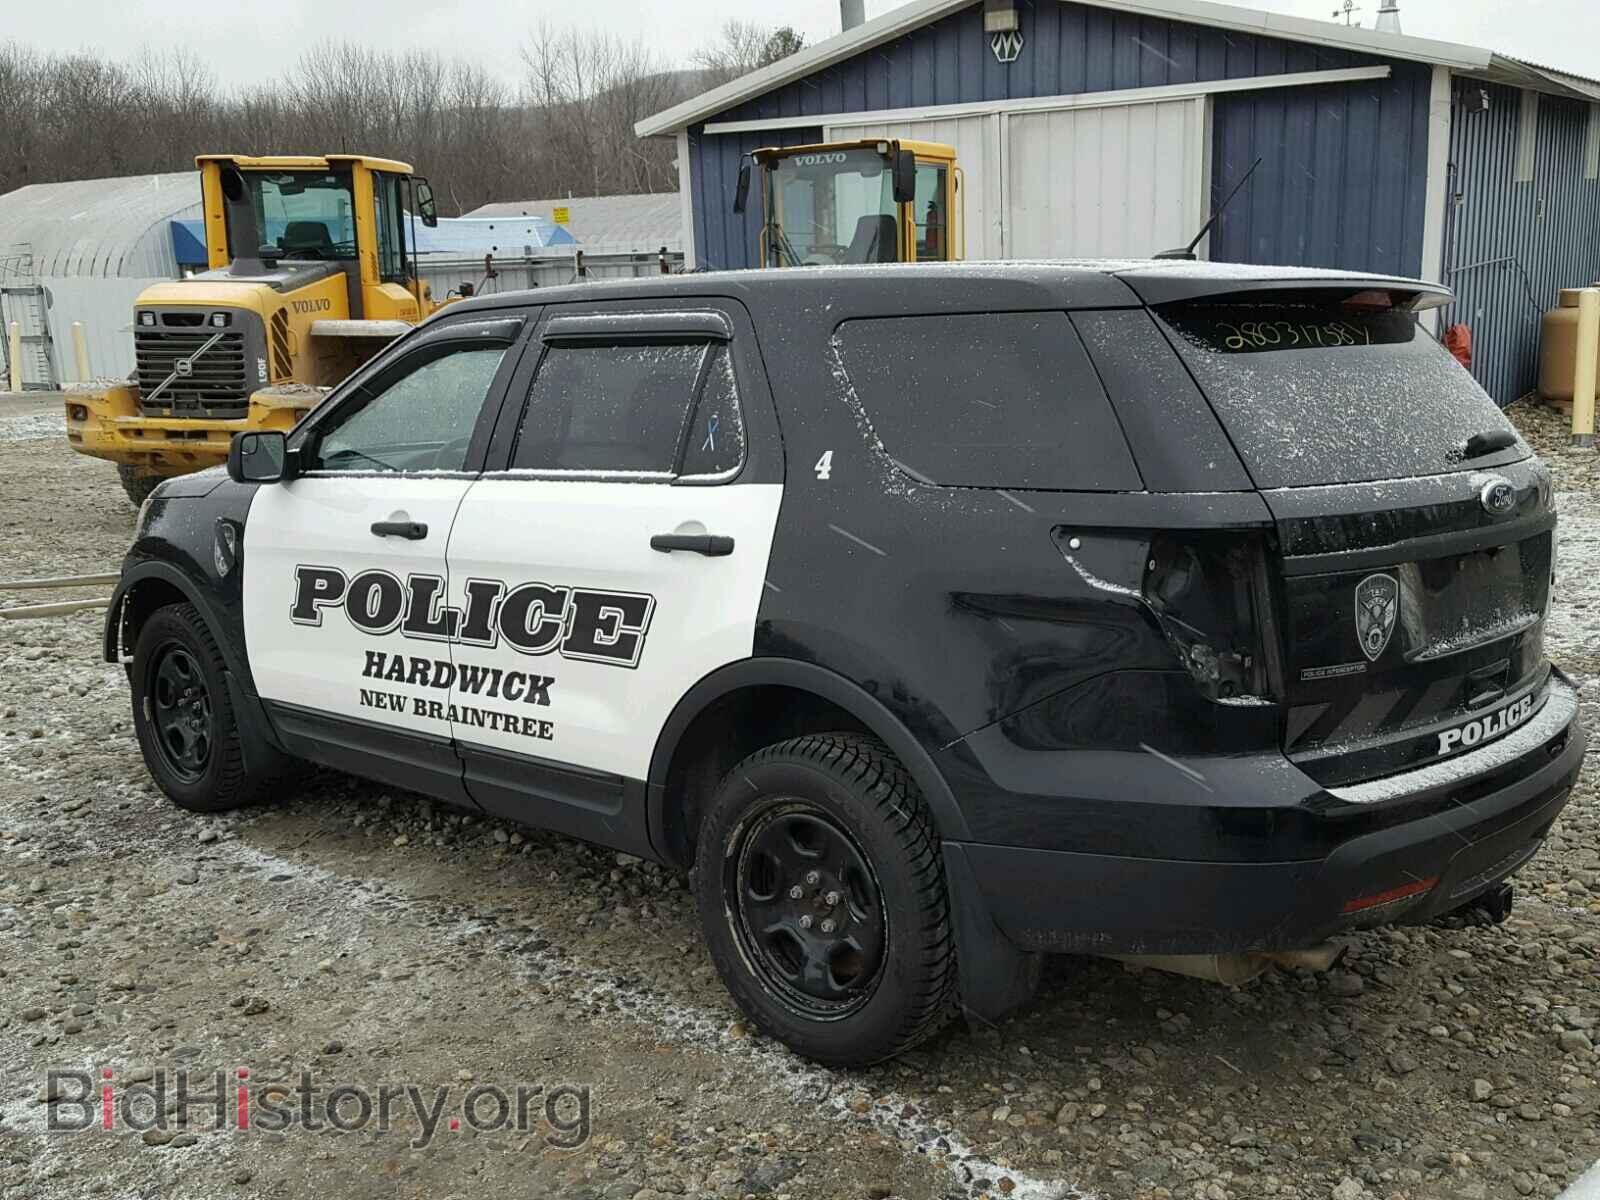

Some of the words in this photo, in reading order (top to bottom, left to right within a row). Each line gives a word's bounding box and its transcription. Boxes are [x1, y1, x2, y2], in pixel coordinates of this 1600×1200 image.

[795, 153, 847, 166] VOLVO
[291, 299, 330, 313] VOLVO
[257, 357, 268, 383] L90F
[814, 450, 833, 480] 4
[290, 564, 657, 669] POLICE
[362, 650, 556, 706] HARDWICK
[359, 689, 406, 713] NEW
[412, 697, 555, 741] BRAINTREE
[1438, 694, 1533, 755] POLICE
